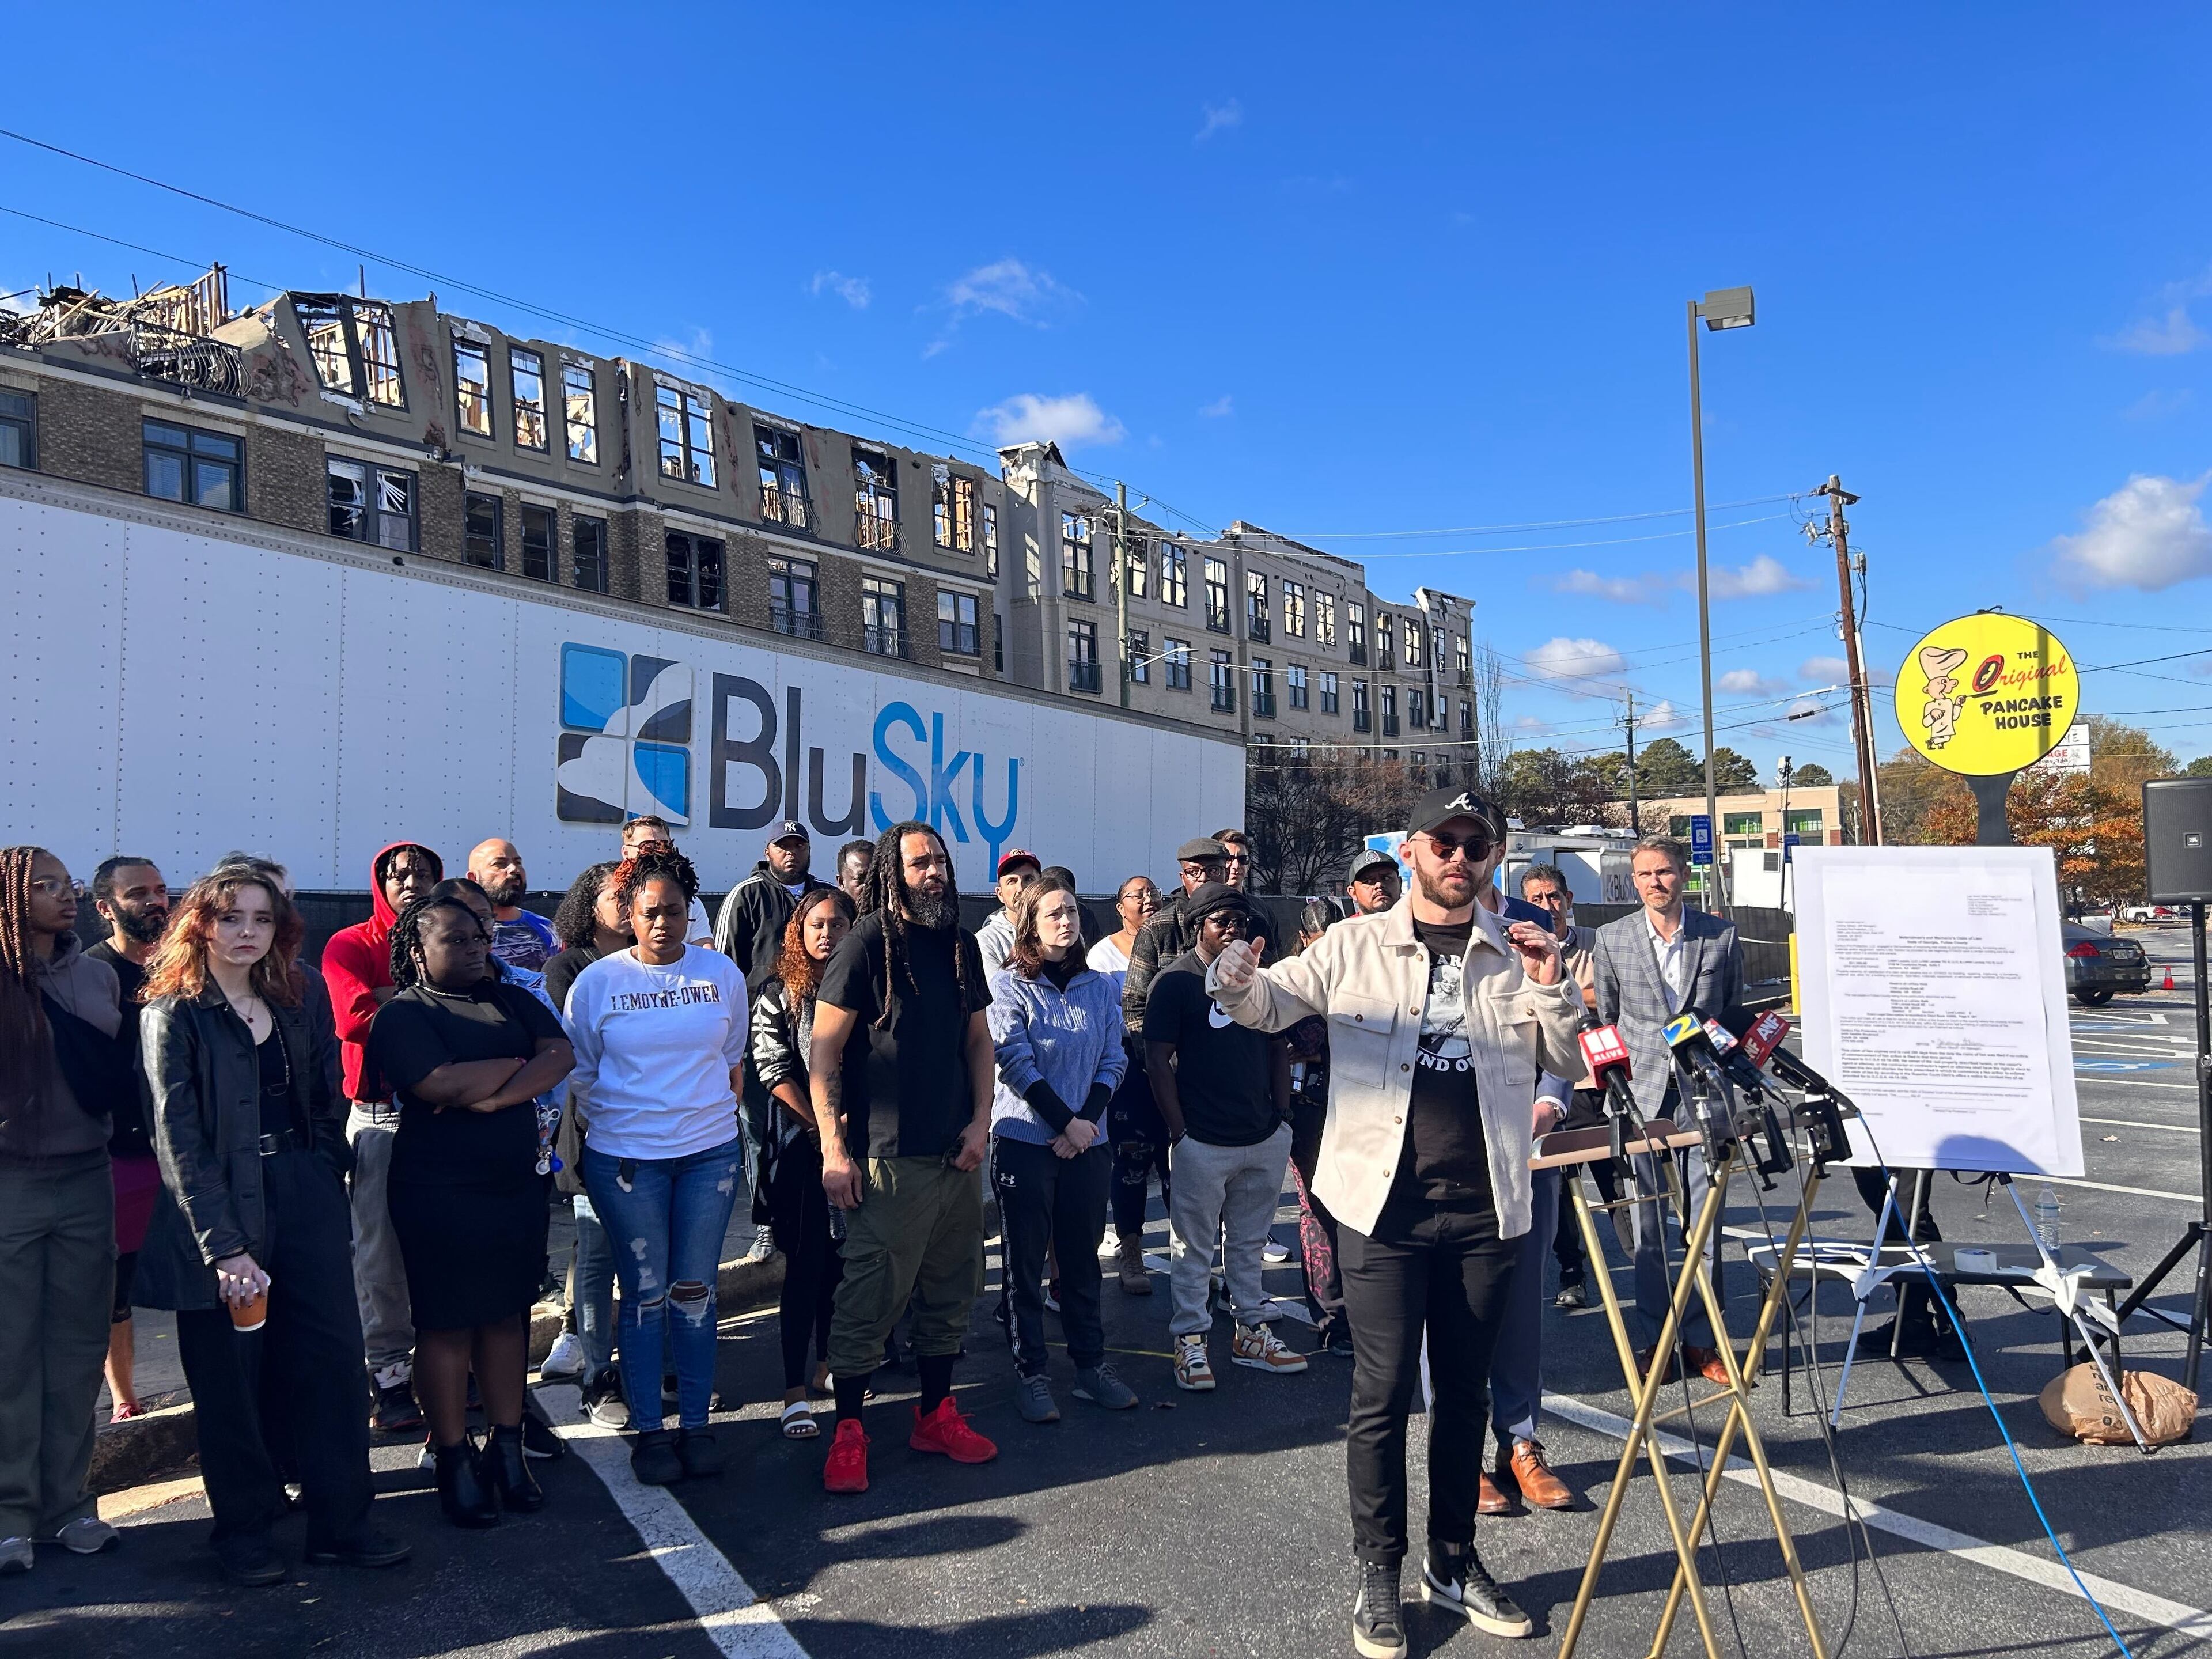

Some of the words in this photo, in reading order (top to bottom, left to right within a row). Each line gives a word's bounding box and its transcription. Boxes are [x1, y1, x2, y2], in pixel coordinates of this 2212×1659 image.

[2017, 650, 2039, 660] THE
[1972, 654, 2067, 692] Original
[1980, 695, 2063, 715] PANCAKE
[1995, 713, 2051, 730] HOUSE
[709, 672, 1018, 883] BluSky
[611, 984, 720, 1010] LEMOYNE-OWEN
[1666, 1016, 1701, 1046] 2
[1594, 1048, 1624, 1062] ALIVE
